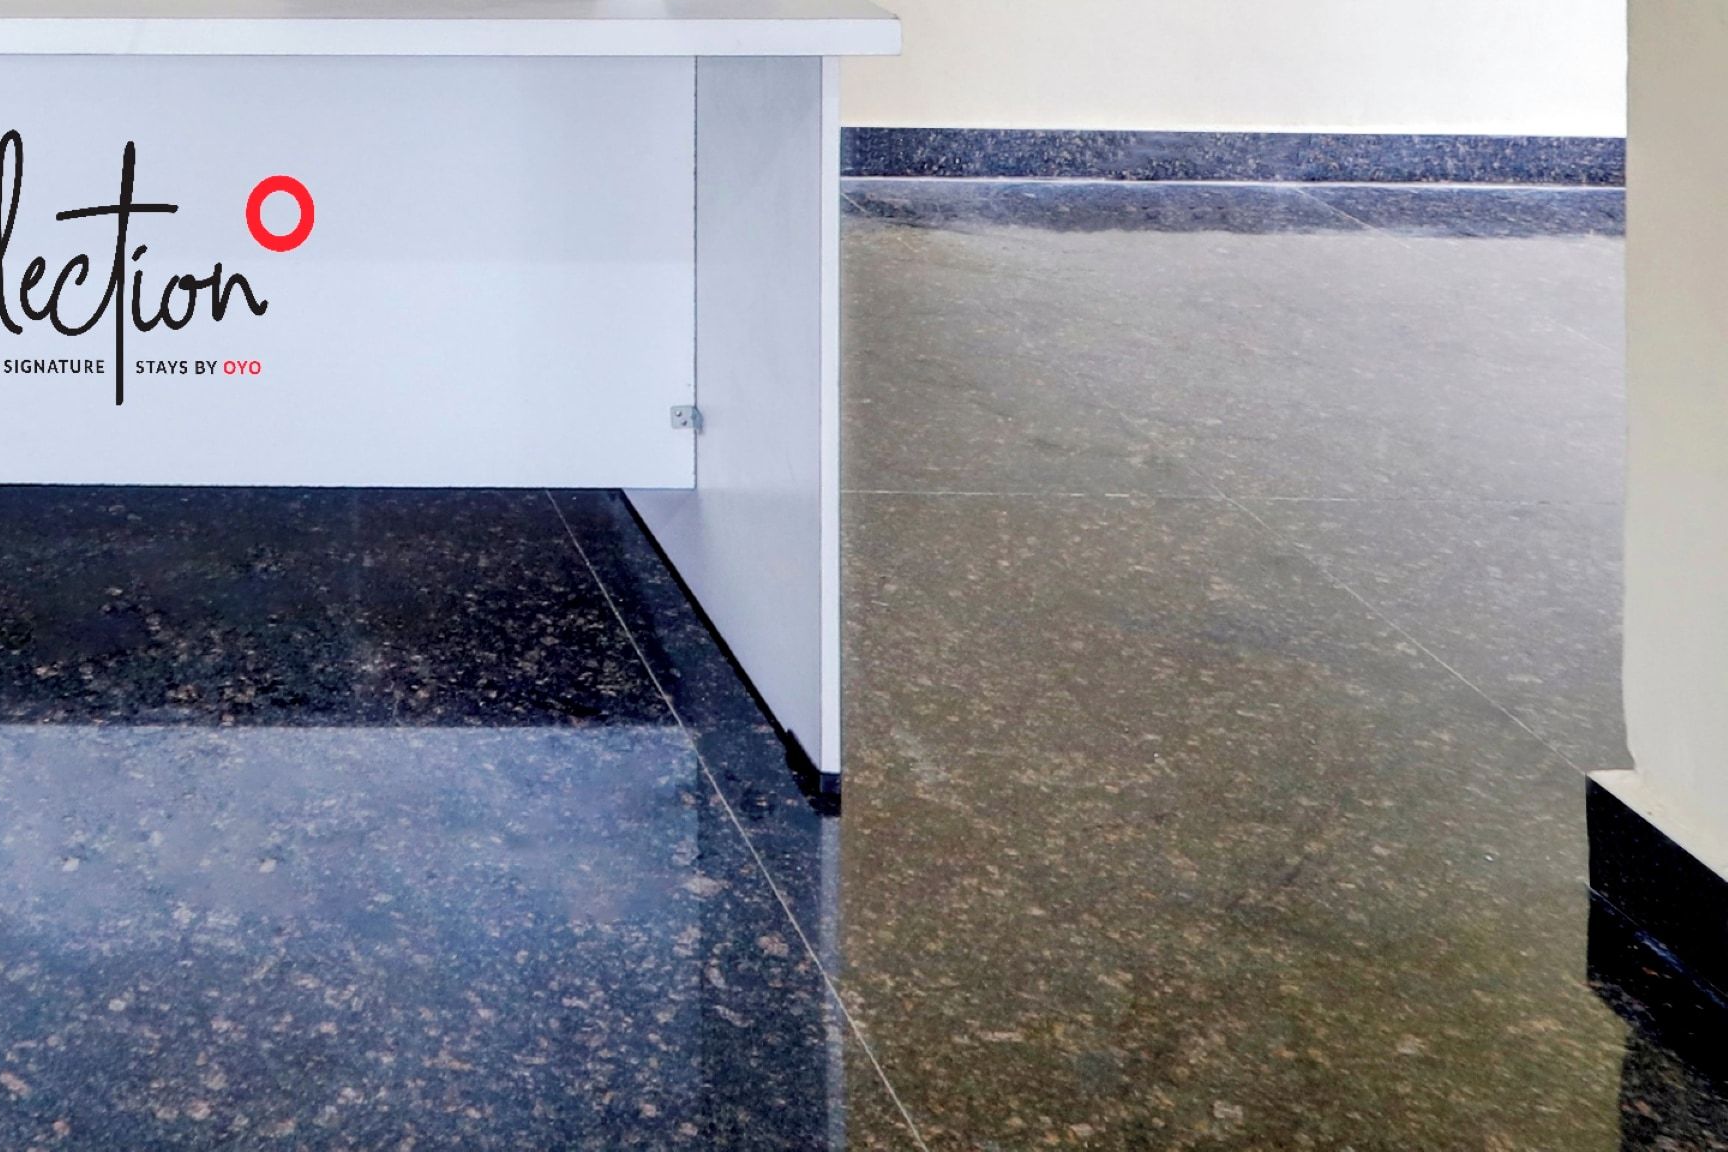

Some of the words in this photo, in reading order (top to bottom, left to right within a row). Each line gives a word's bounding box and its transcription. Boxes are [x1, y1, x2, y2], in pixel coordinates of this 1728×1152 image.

[3, 359, 105, 375] SIGNATURE
[135, 359, 188, 375] STAYS
[194, 360, 218, 375] BY
[223, 360, 262, 375] OYO
